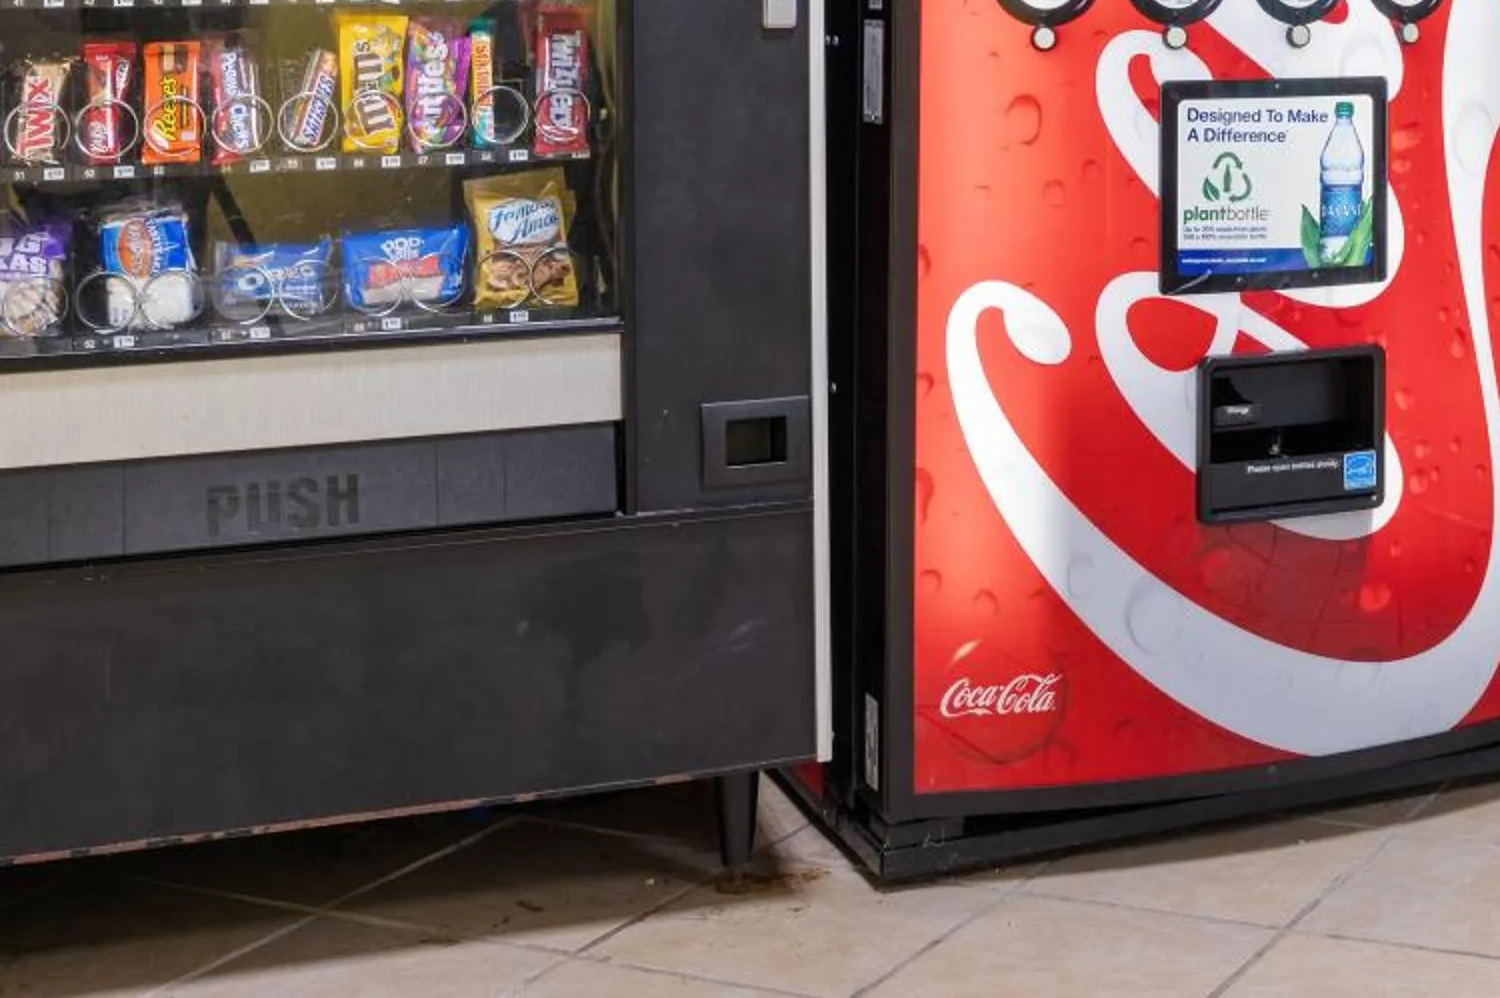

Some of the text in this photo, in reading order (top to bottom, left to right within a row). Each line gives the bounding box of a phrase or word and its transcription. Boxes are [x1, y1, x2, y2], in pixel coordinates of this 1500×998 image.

[16, 77, 56, 158] TWIX
[1187, 107, 1329, 126] Designed To Make
[1187, 127, 1287, 143] A Difference
[1183, 205, 1269, 224] plantbottle
[206, 472, 360, 537] PUSH
[939, 673, 1063, 718] Coca-Cola
